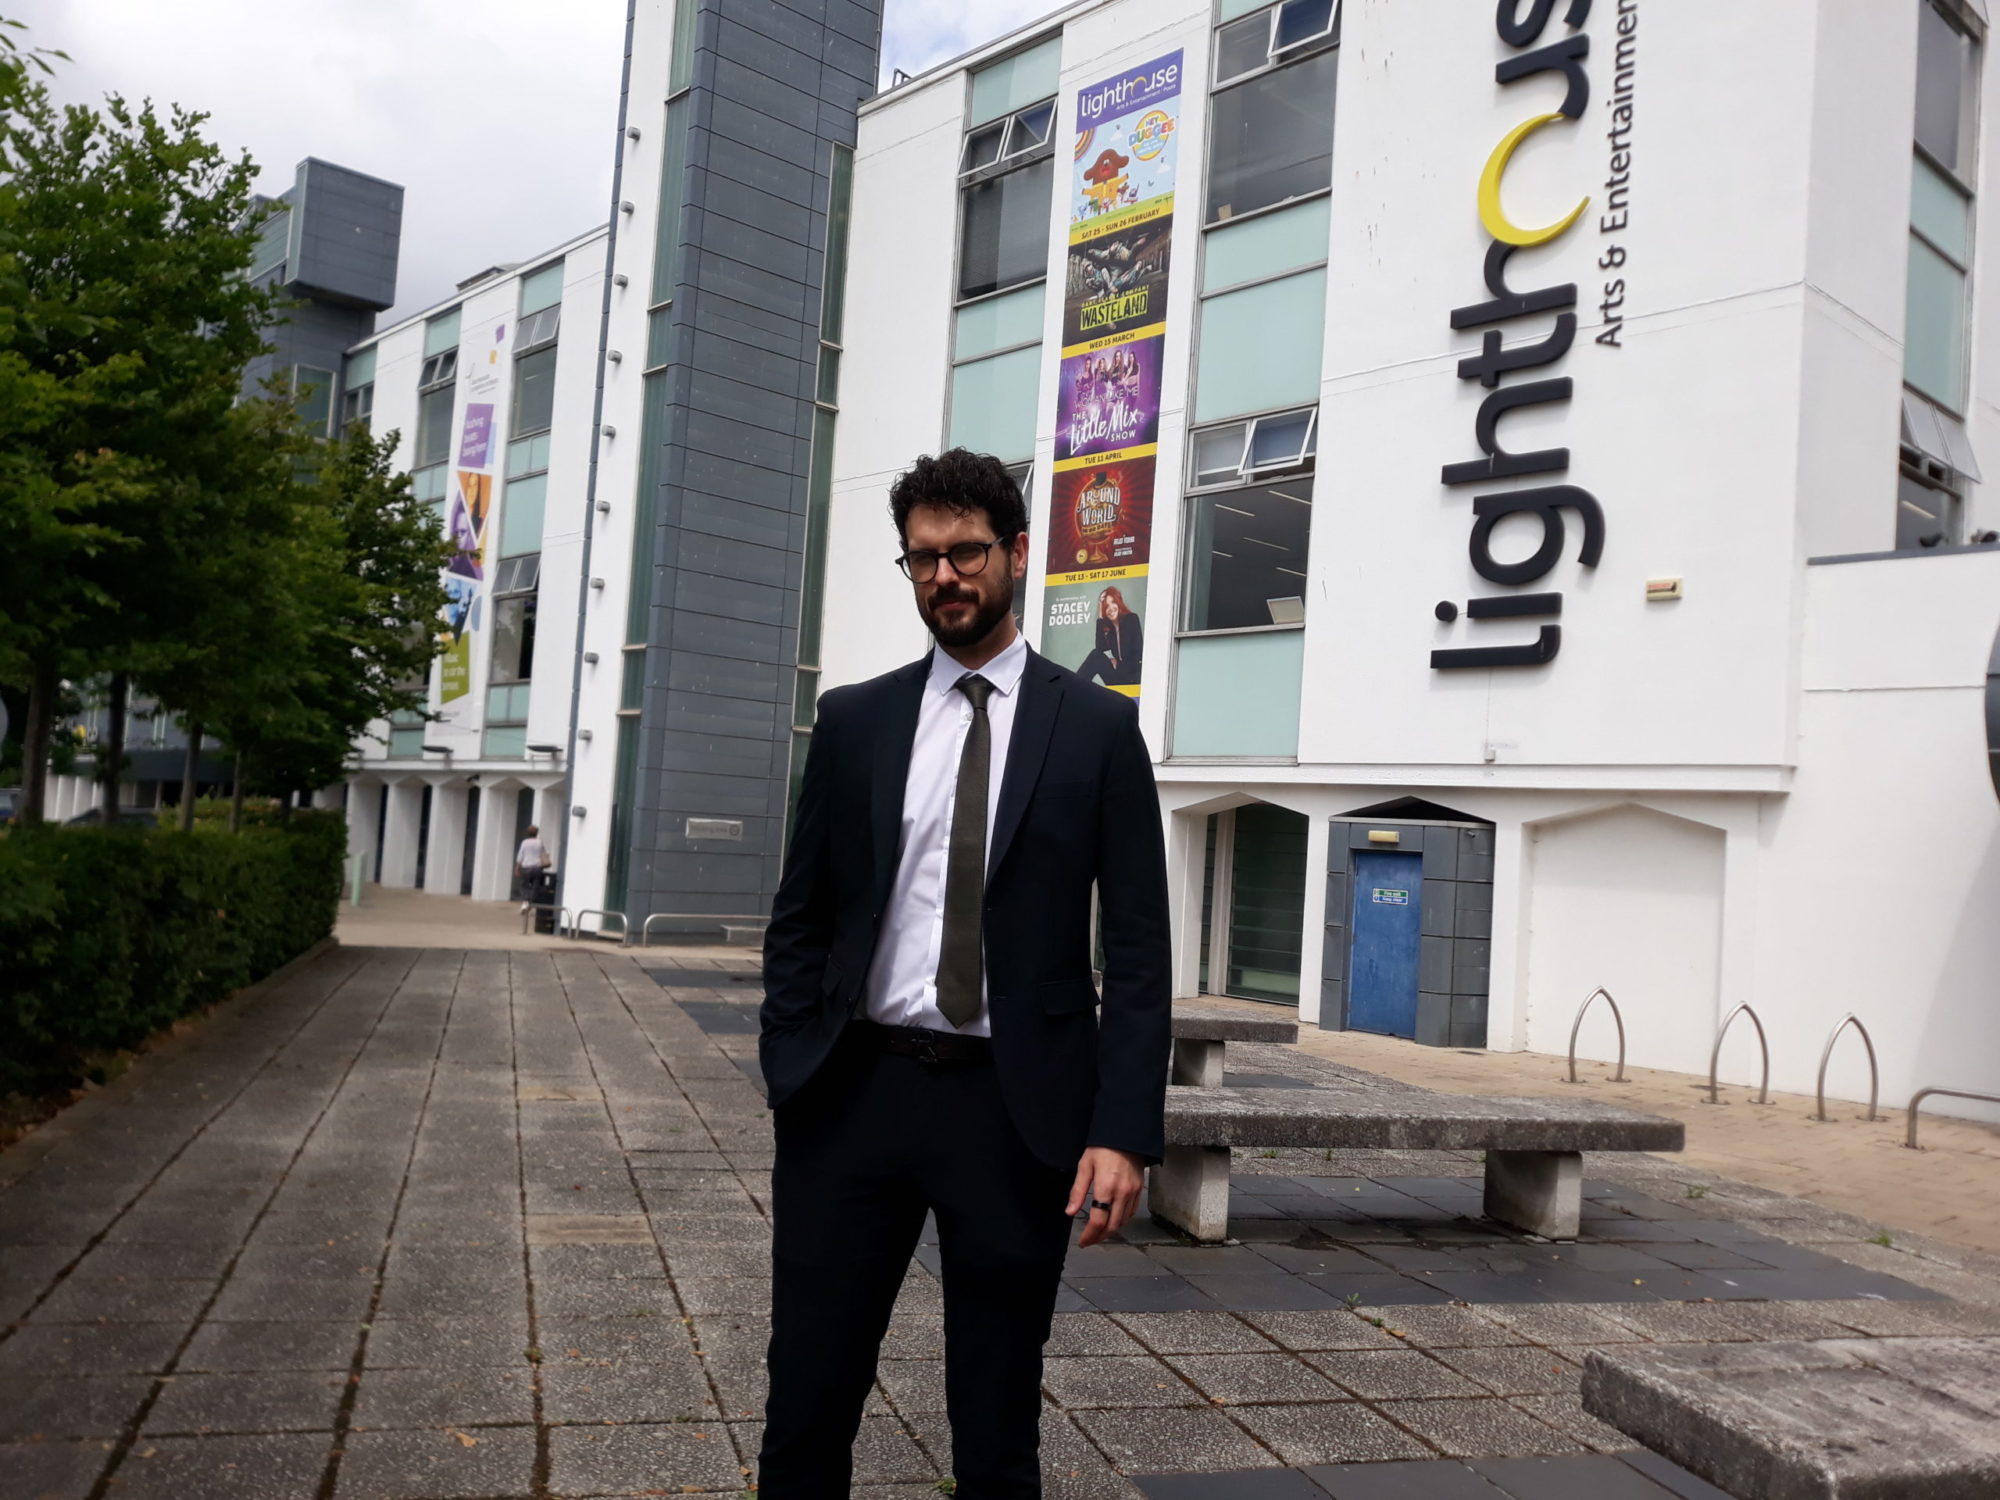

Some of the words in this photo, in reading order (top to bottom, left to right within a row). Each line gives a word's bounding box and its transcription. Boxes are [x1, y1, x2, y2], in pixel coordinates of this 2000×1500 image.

[1082, 64, 1178, 119] lighthouse
[1146, 115, 1159, 127] HEY
[1129, 118, 1175, 147] DUGGEE
[1081, 229, 1092, 239] SAT
[1093, 227, 1101, 236] 25
[1105, 221, 1118, 231] SUN
[1120, 219, 1127, 227] 26
[1128, 208, 1160, 225] FEBRUARY
[1598, 244, 1626, 270] &
[1081, 293, 1147, 329] WASTELAND
[1595, 278, 1625, 348] Arts
[1089, 340, 1103, 350] WED
[1104, 338, 1112, 346] 15
[1112, 332, 1135, 345] MARCH
[1072, 411, 1086, 422] THE
[1105, 400, 1139, 440] Mix
[1111, 429, 1136, 442] SHOW
[1085, 457, 1096, 465] TUE
[1097, 455, 1104, 463] 11
[1105, 452, 1122, 460] APRIL
[1077, 487, 1121, 512] AROUND
[1082, 504, 1116, 526] WORLD
[1065, 574, 1077, 582] TUE
[1089, 571, 1101, 580] SAT
[1101, 570, 1109, 578] 17
[1109, 568, 1127, 577] JUNE
[1051, 601, 1091, 615] STACEY
[1049, 612, 1091, 627] DOOLEY
